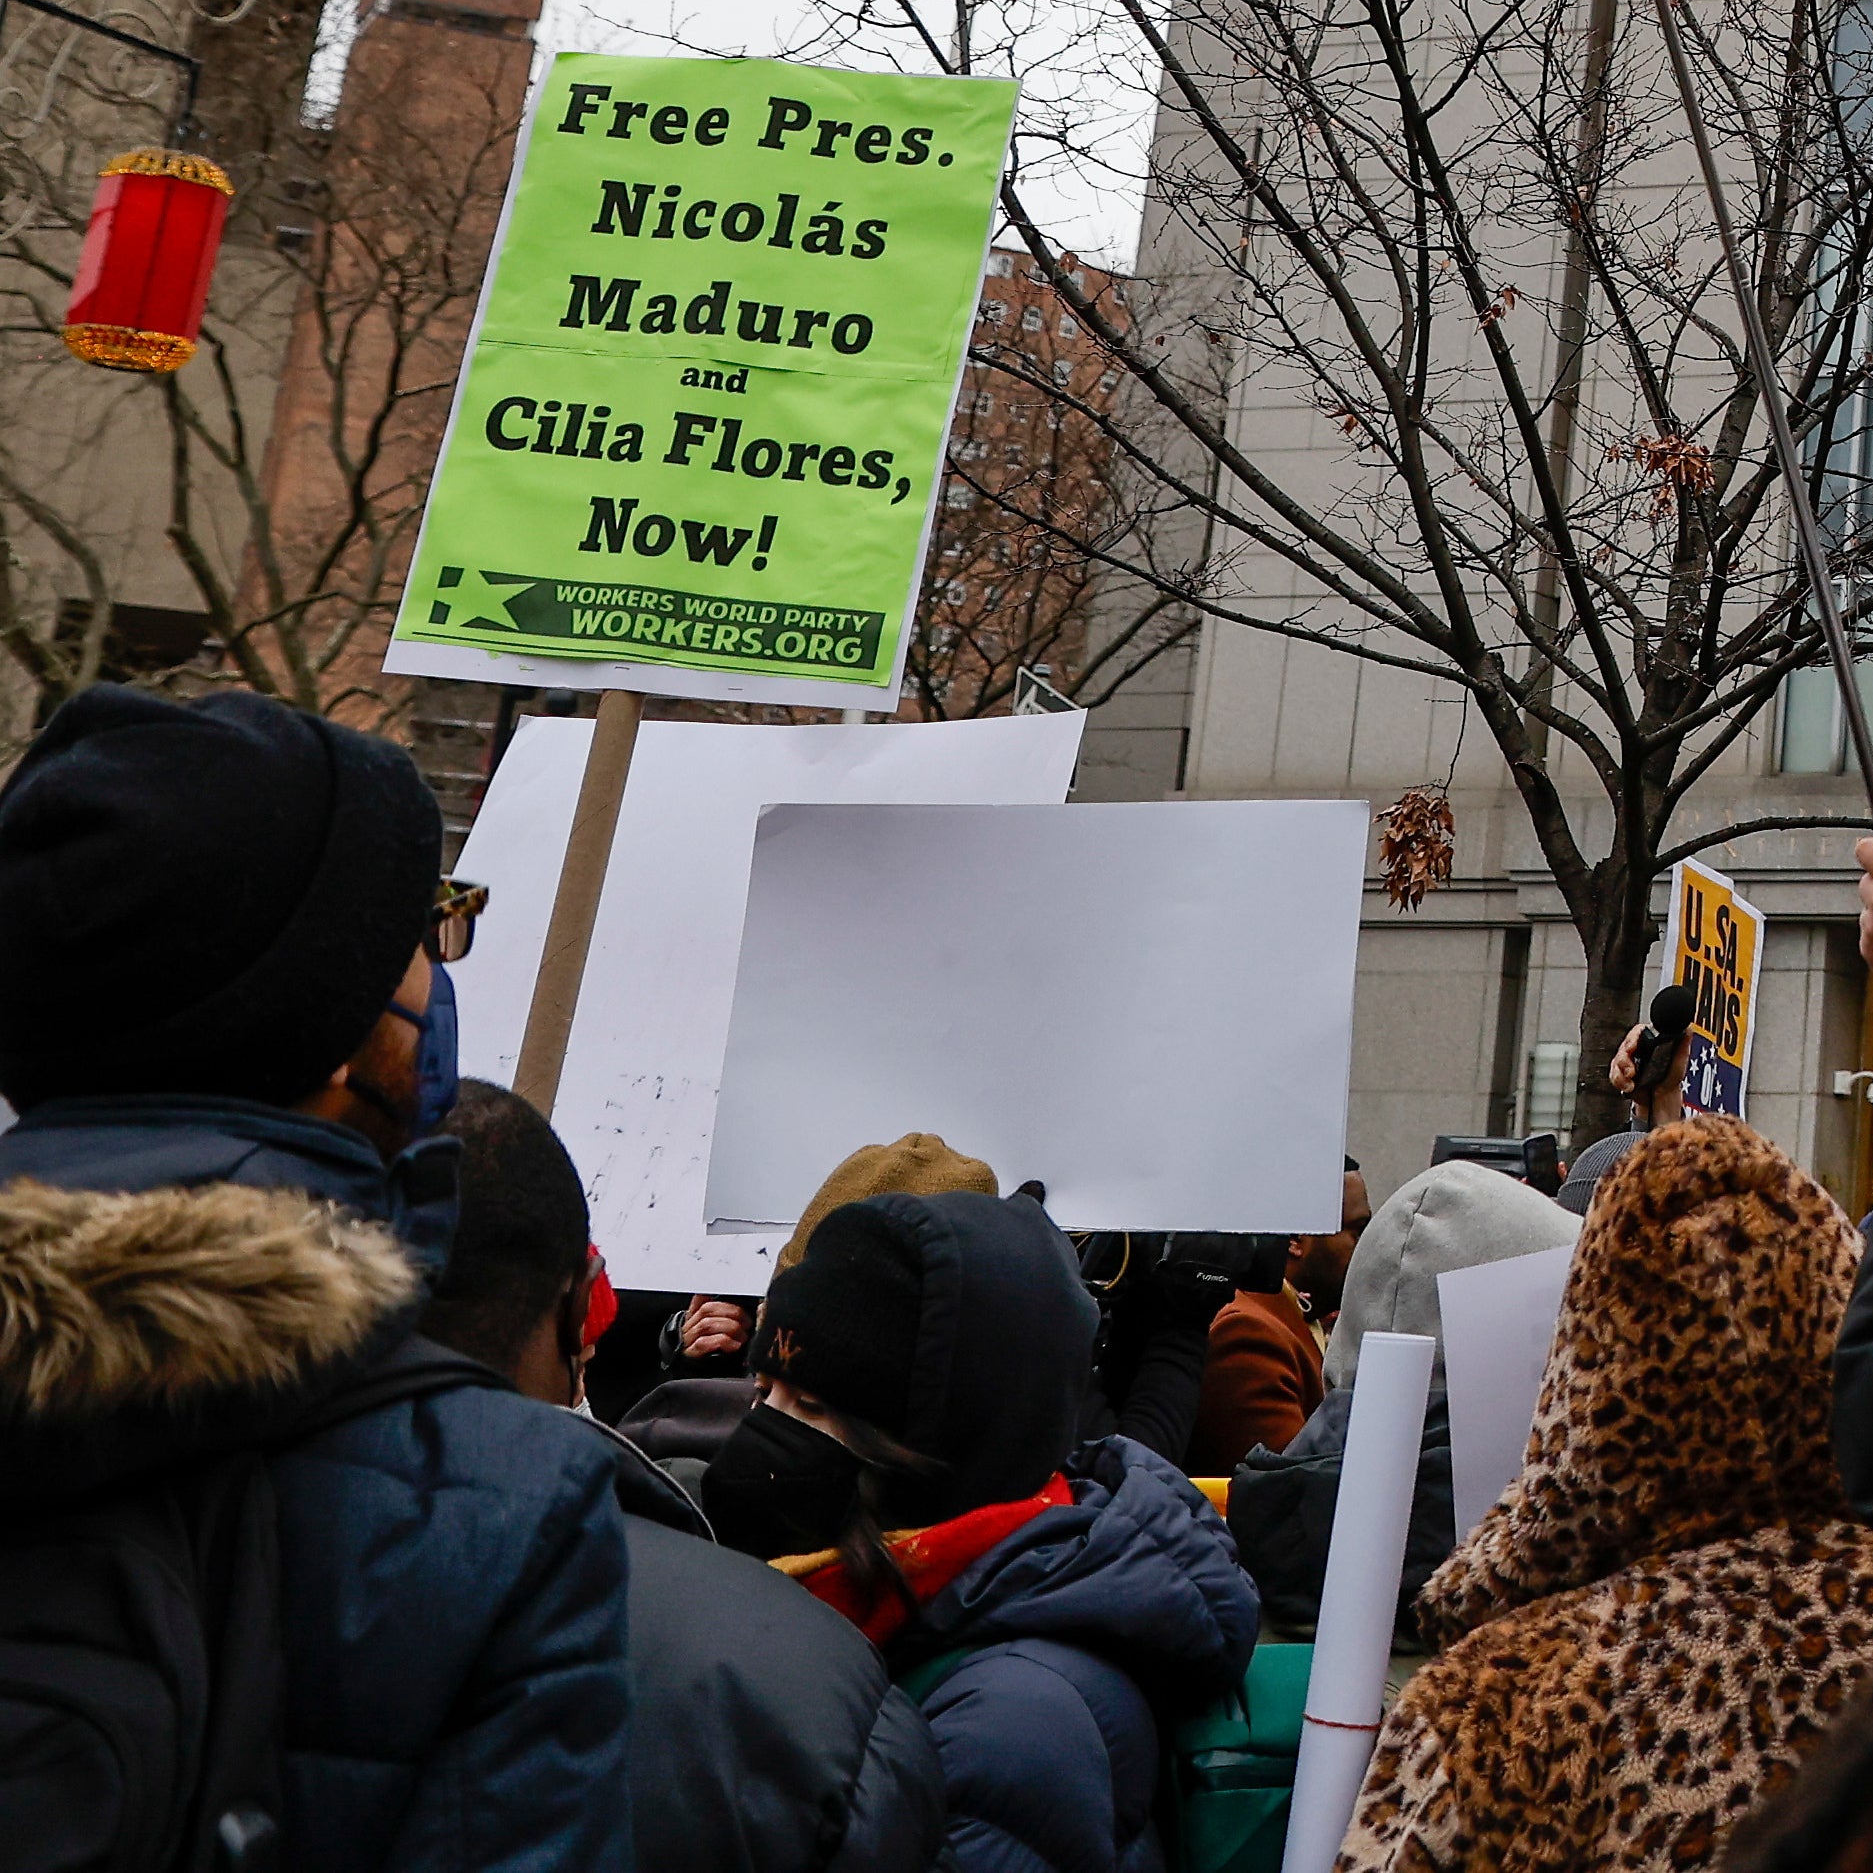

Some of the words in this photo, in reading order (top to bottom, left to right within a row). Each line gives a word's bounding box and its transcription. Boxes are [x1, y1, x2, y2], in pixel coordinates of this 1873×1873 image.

[557, 83, 730, 146] Free
[757, 96, 956, 168] Pres.
[590, 179, 889, 261] Nicolás
[559, 273, 874, 355] Maduro
[679, 361, 748, 395] and
[485, 395, 643, 463] Cilia
[662, 412, 913, 506] Flores,
[577, 496, 780, 572] Now!
[555, 585, 675, 612] WORKERS
[684, 597, 778, 624] WORLD
[783, 609, 870, 633] PARTY
[571, 608, 863, 664] WORKERS.ORG
